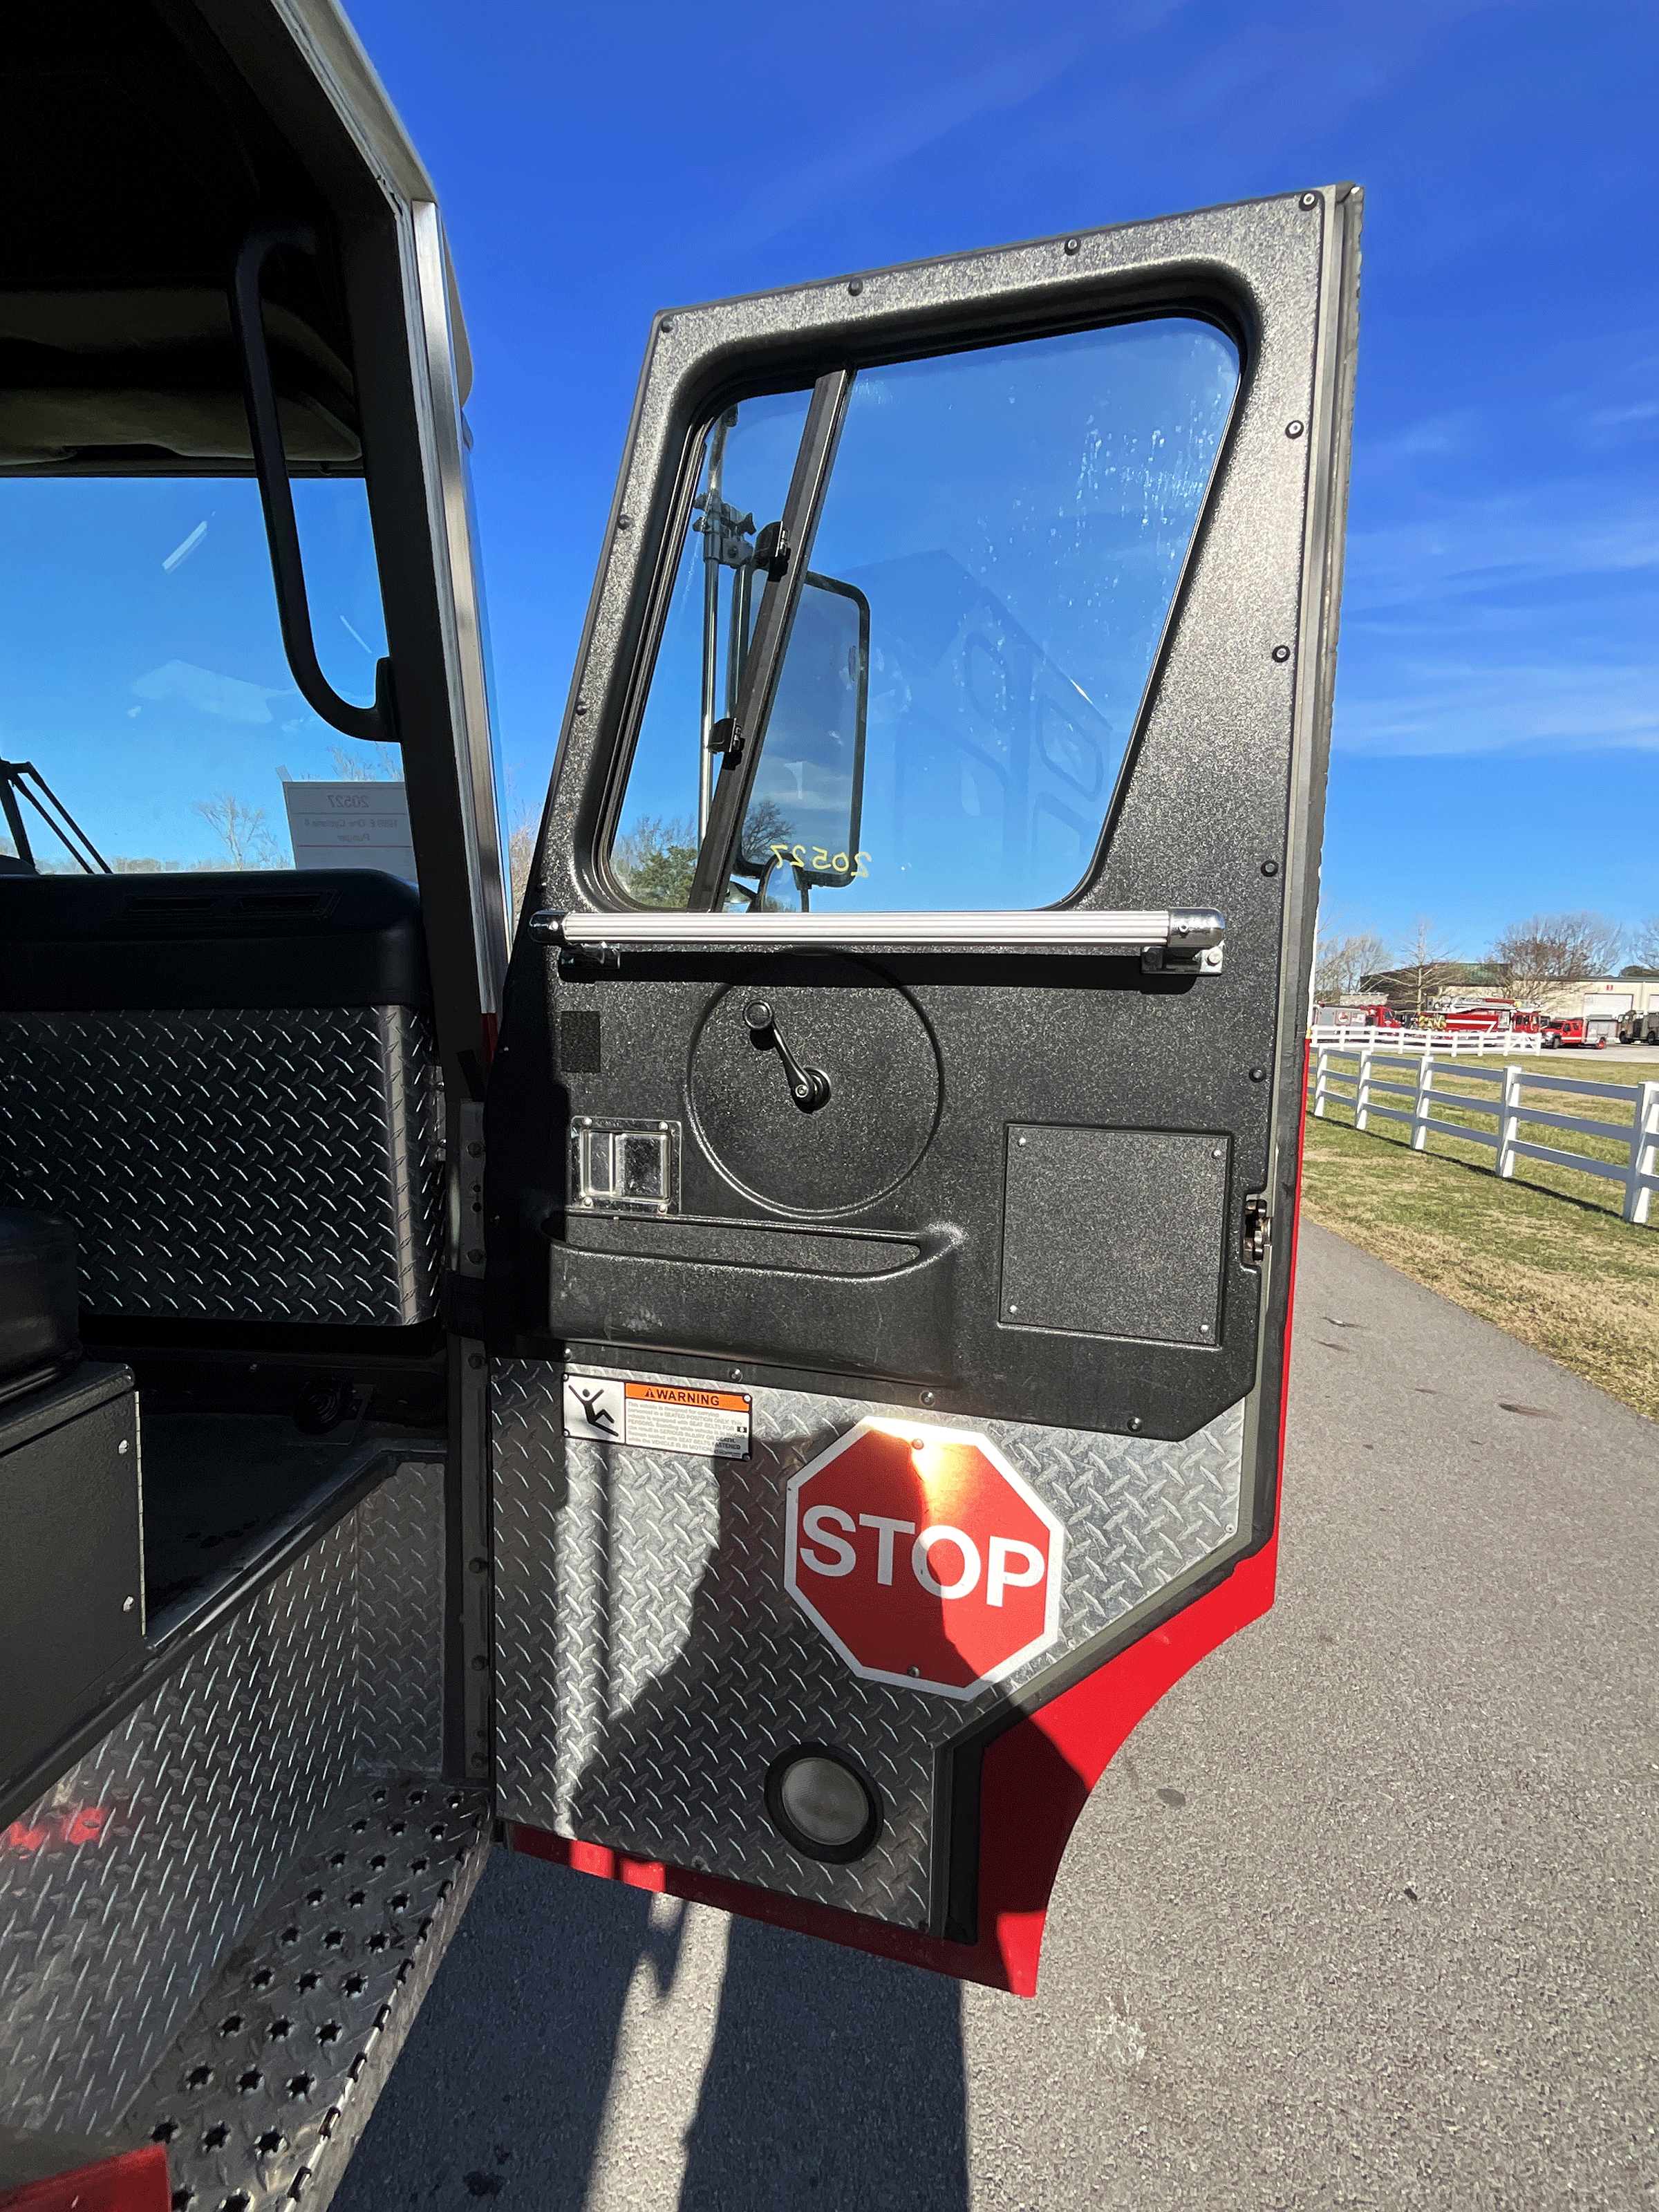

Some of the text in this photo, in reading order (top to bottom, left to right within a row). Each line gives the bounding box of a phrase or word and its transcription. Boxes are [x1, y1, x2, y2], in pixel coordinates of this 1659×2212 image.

[656, 1389, 720, 1406] WARNING
[686, 1414, 713, 1423] POSITION
[656, 1422, 679, 1430] Standing
[659, 1428, 684, 1436] SERIOUS
[712, 1441, 741, 1450] FASTENED
[800, 1505, 1045, 1607] STOP
